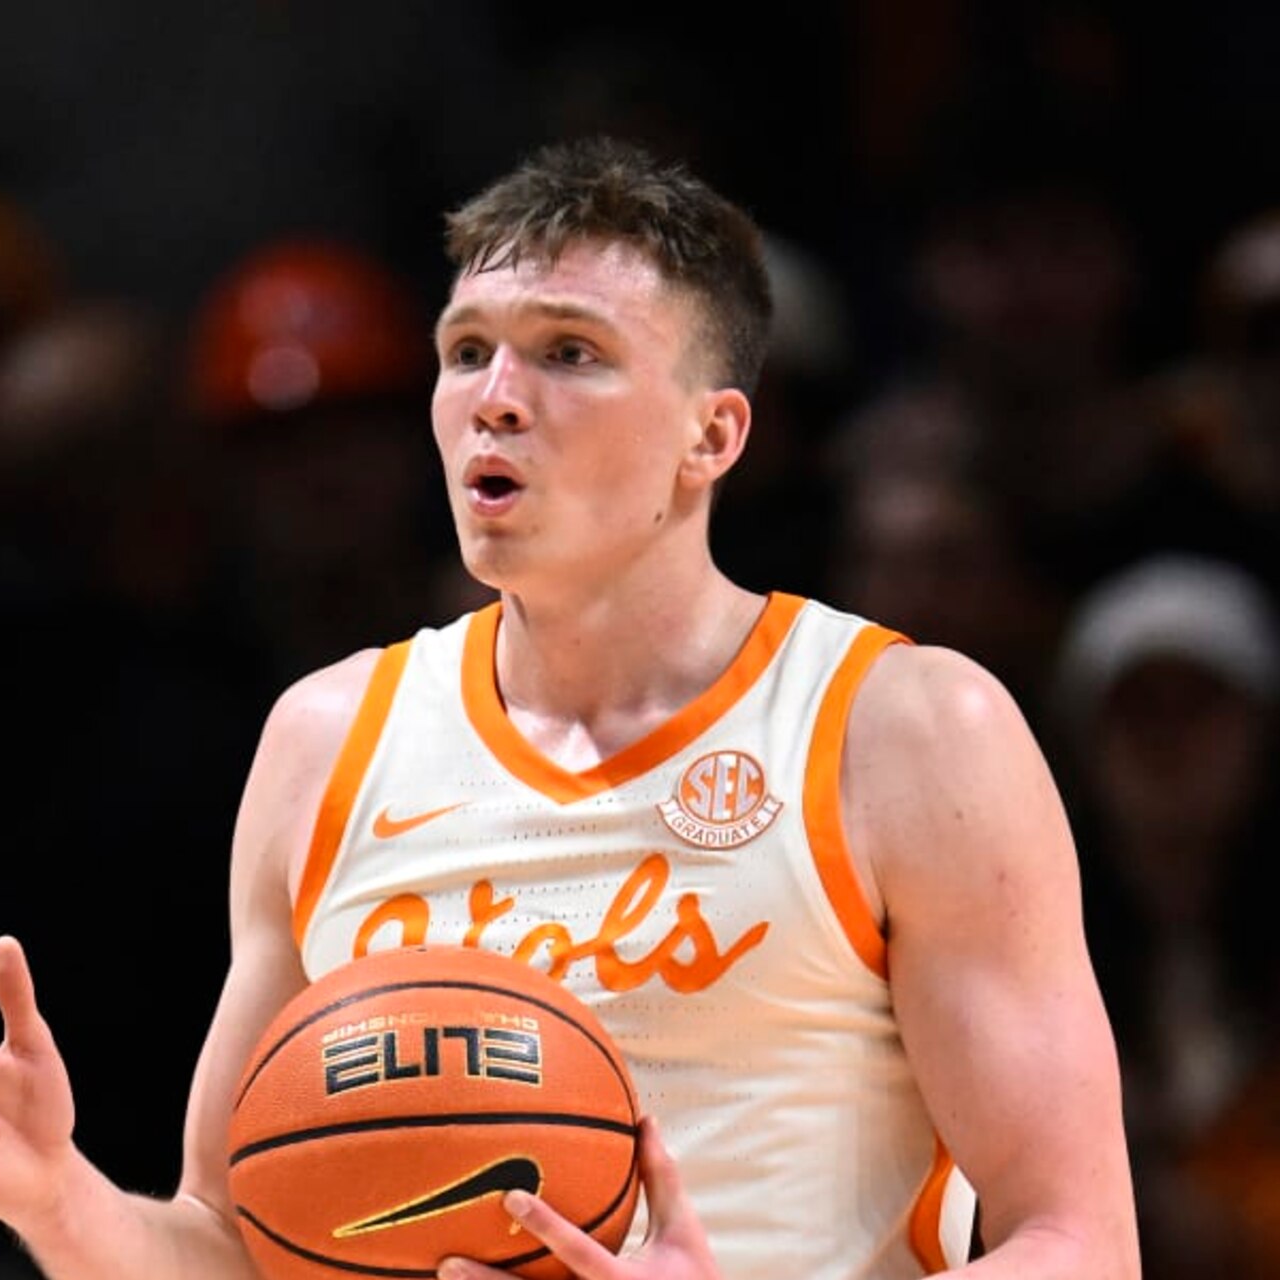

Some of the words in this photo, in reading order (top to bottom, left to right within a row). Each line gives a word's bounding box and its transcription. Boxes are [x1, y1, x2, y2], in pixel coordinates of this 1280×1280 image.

[685, 754, 760, 820] SEC
[672, 814, 765, 845] GRADUATE
[322, 1010, 539, 1044] CHAONSHIP
[321, 1027, 542, 1098] ELITE
